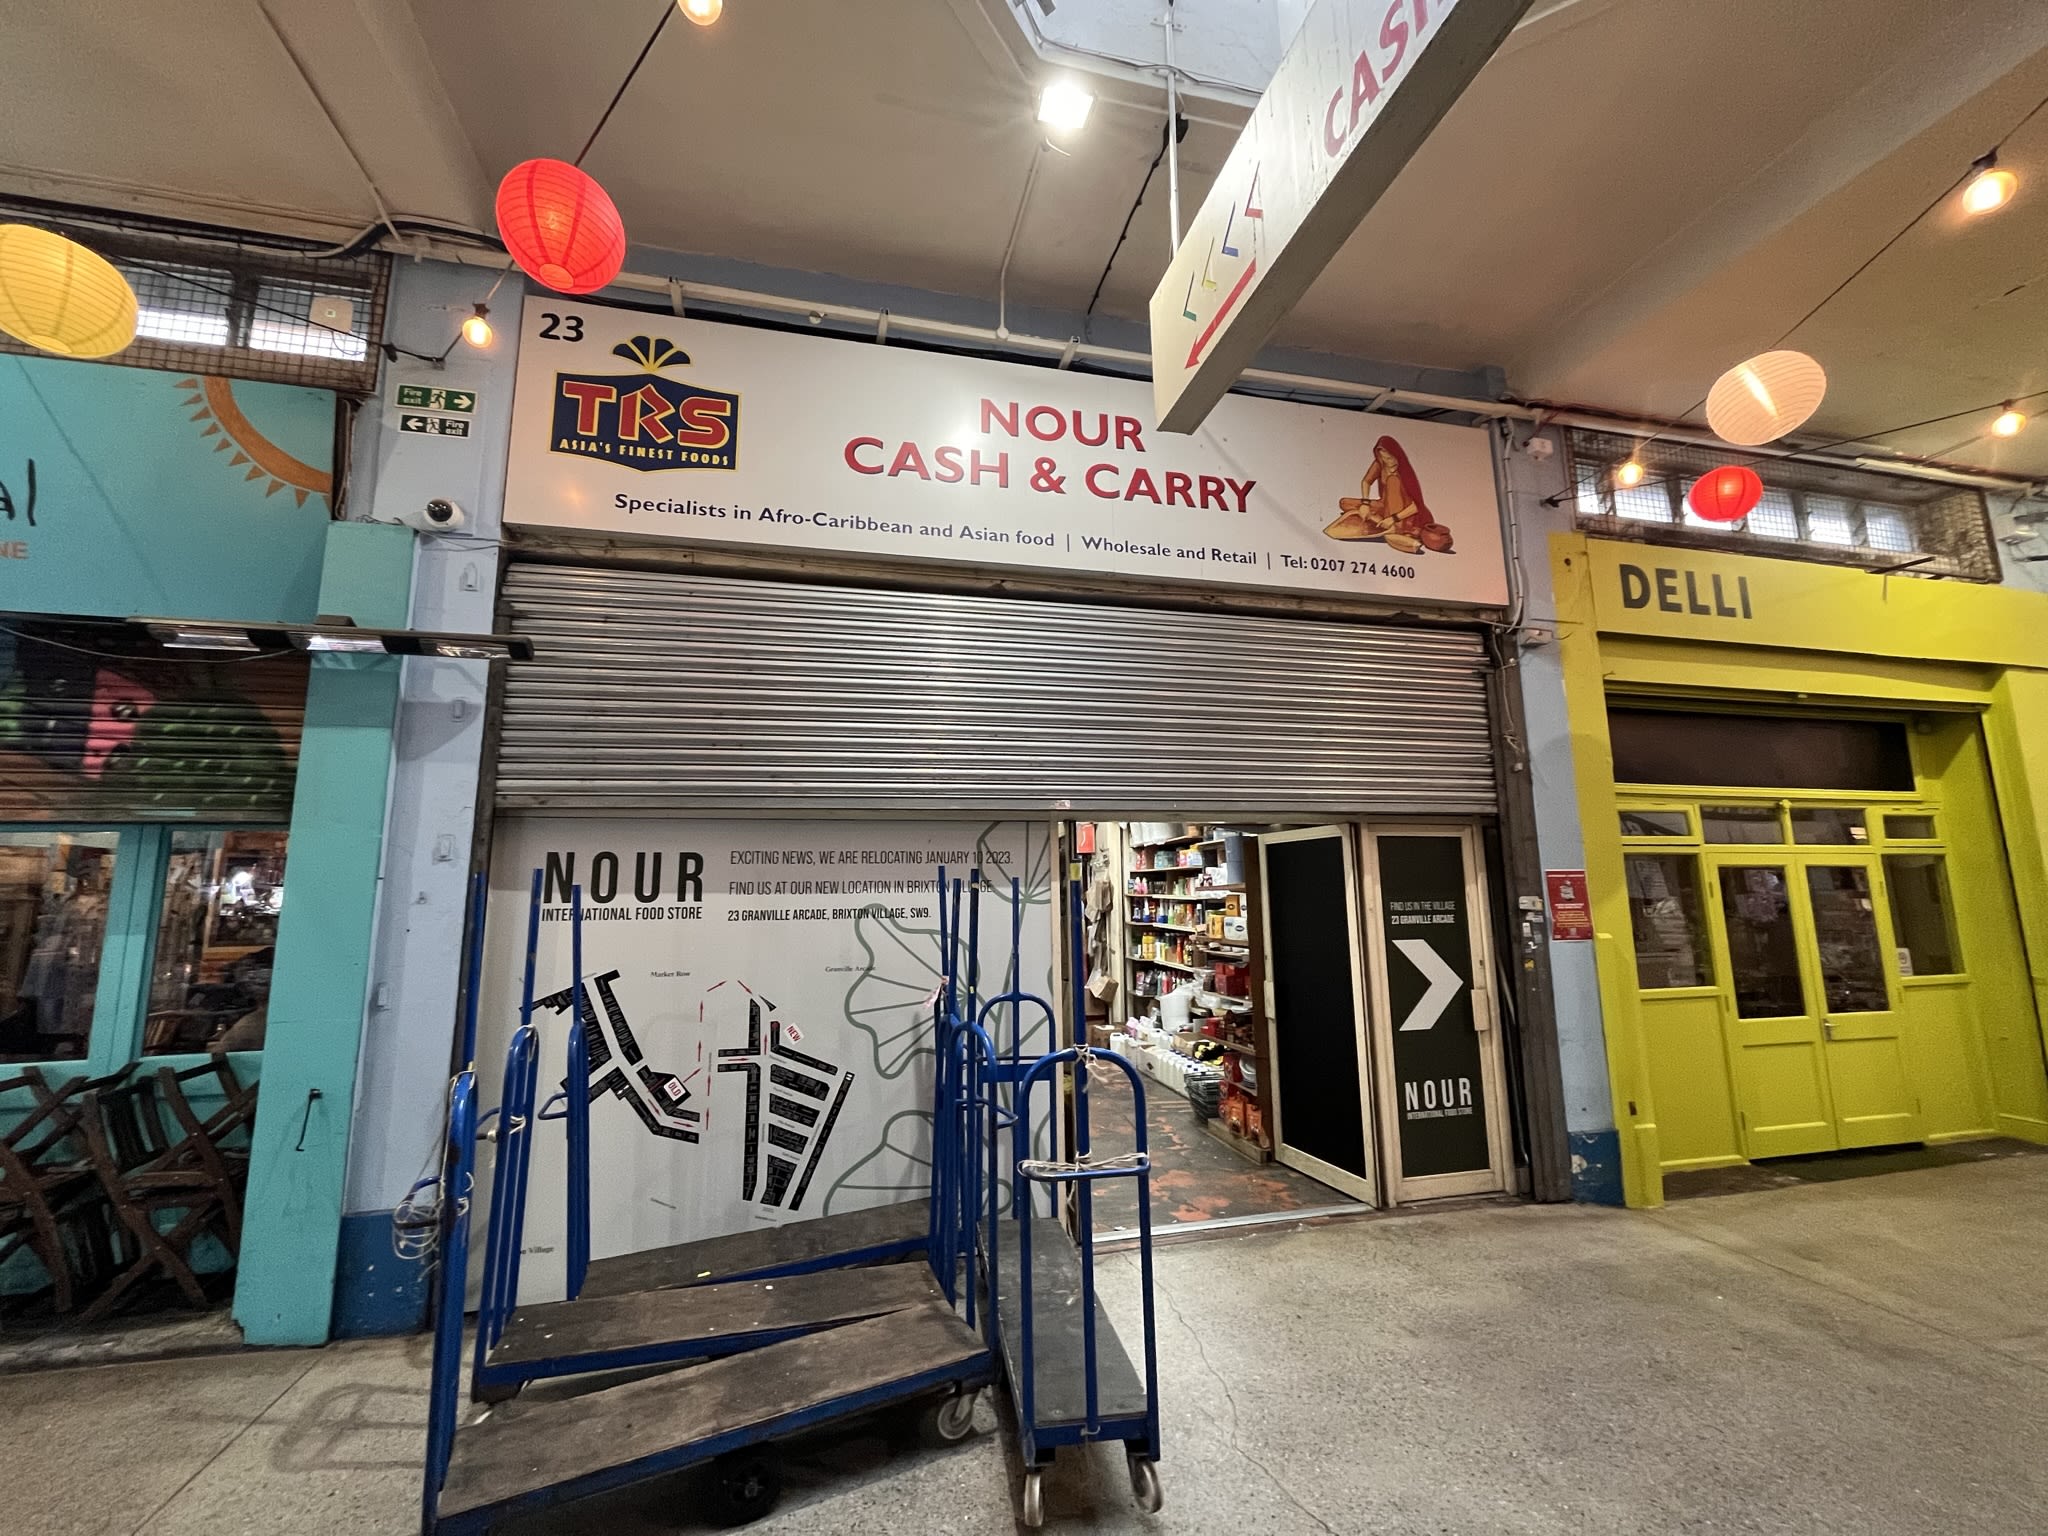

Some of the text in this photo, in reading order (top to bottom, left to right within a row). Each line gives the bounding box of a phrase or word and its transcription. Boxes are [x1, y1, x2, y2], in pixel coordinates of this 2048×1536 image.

[538, 313, 584, 342] 23
[403, 388, 422, 397] Fire
[445, 420, 464, 429] Fire
[562, 380, 732, 449] TRS
[980, 398, 1147, 452] NOUR
[445, 428, 463, 436] exit
[559, 438, 729, 466] ASIA'S FINEST FOODS
[843, 436, 1257, 513] CASH & CARRY
[615, 493, 726, 518] Specialists
[734, 504, 751, 520] in
[758, 507, 913, 534] Afro-Caribbean
[919, 524, 953, 538] and
[959, 525, 1009, 542] Asian
[1015, 530, 1055, 546] food
[1081, 535, 1171, 557] Wholesale
[1177, 547, 1205, 560] and
[1211, 548, 1257, 565] Retail
[1310, 557, 1345, 572] 0207
[1350, 561, 1376, 575] 274
[1381, 565, 1415, 579] 4600
[1619, 563, 1752, 619] DELLI
[730, 850, 1014, 866] EXCITING NEWS, WE ARE RELOCATING JANUARY 10 2023.
[543, 851, 704, 904] NOUR
[729, 881, 754, 895] FIND
[757, 881, 772, 895] US
[774, 881, 788, 895] AT
[790, 881, 812, 895] OUR
[815, 880, 840, 894] NEW
[842, 880, 893, 894] LOCATION
[894, 880, 904, 894] IN
[635, 907, 664, 920] FOOD
[667, 906, 703, 920] STORE
[728, 910, 739, 922] 23
[742, 909, 791, 921] GRANVILLE
[792, 909, 830, 921] ARCADE,
[832, 908, 869, 920] BRIXTON
[872, 907, 908, 919] VILLAGE,
[786, 1025, 801, 1043] NEW
[668, 1082, 682, 1098] OLD
[1404, 1077, 1472, 1111] NOUR
